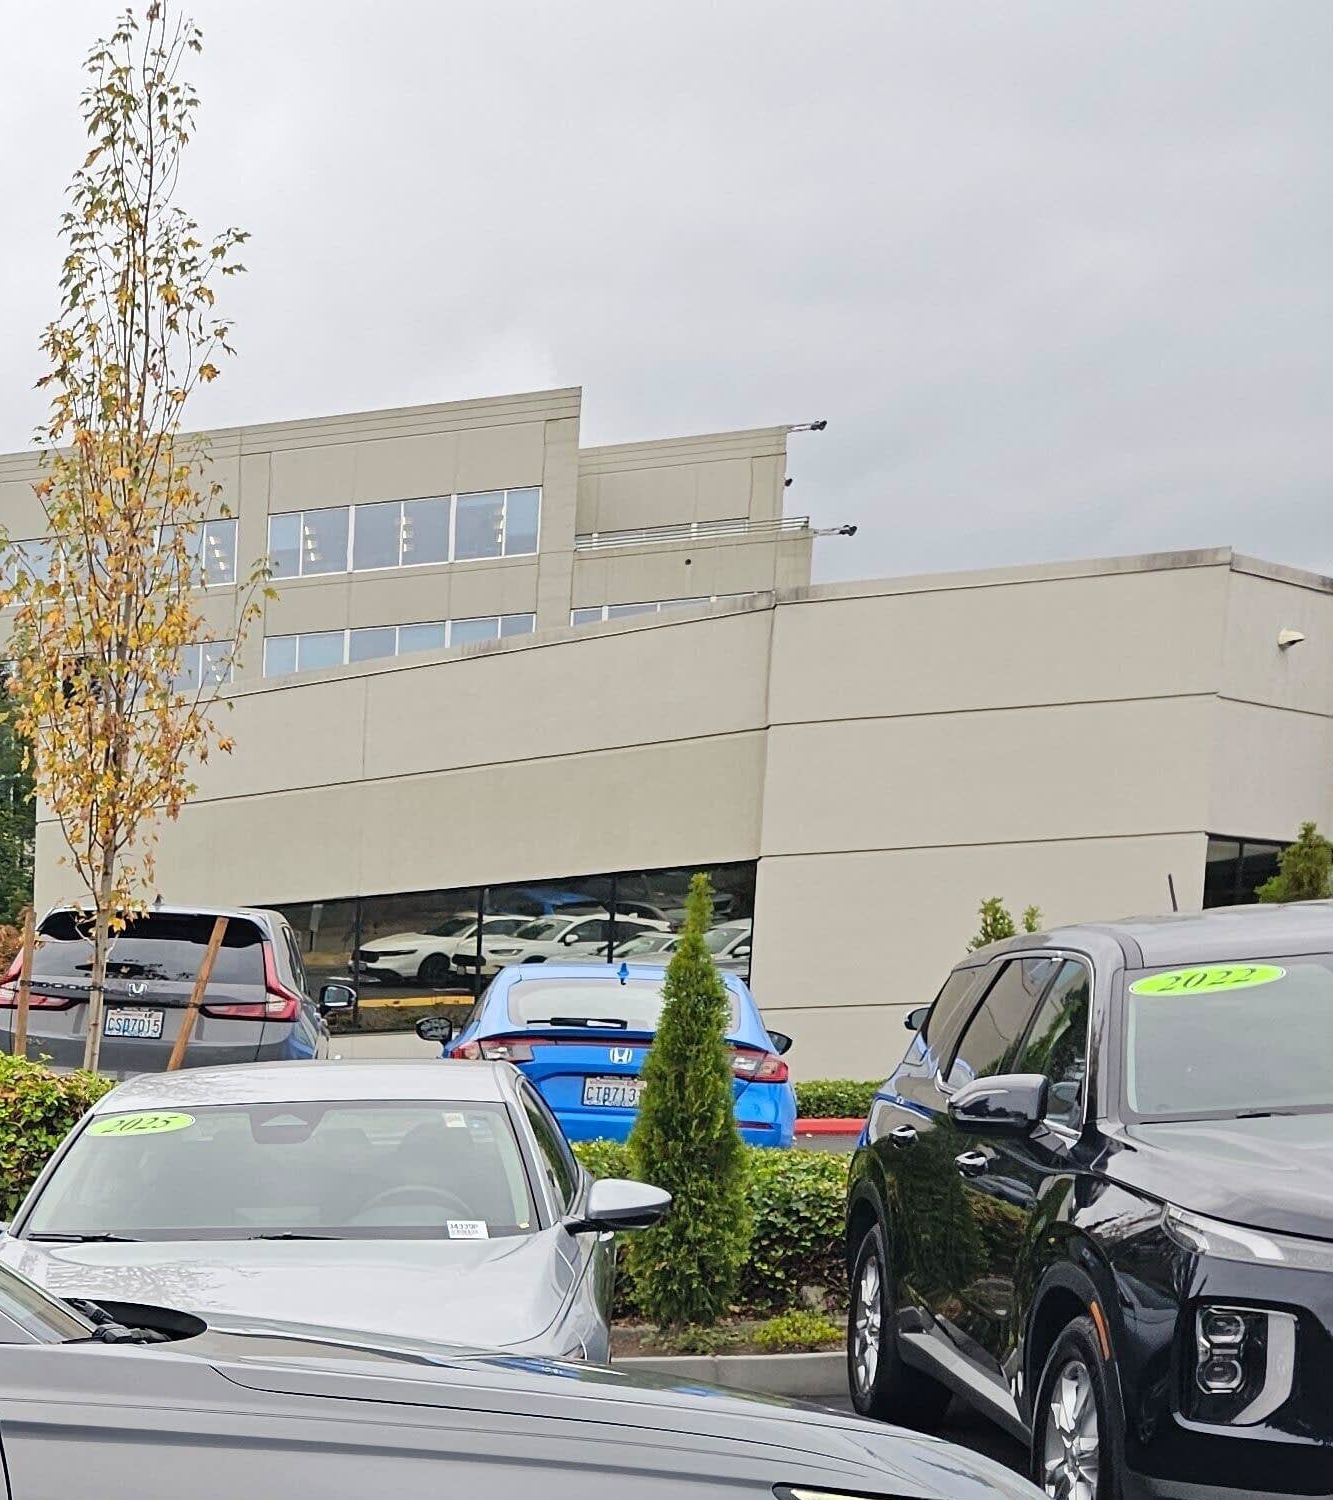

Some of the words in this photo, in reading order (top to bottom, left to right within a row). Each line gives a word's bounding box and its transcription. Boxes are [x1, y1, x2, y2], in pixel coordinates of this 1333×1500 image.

[1156, 968, 1257, 992] 2022
[586, 1086, 640, 1103] CTB713
[101, 1116, 178, 1133] 2025
